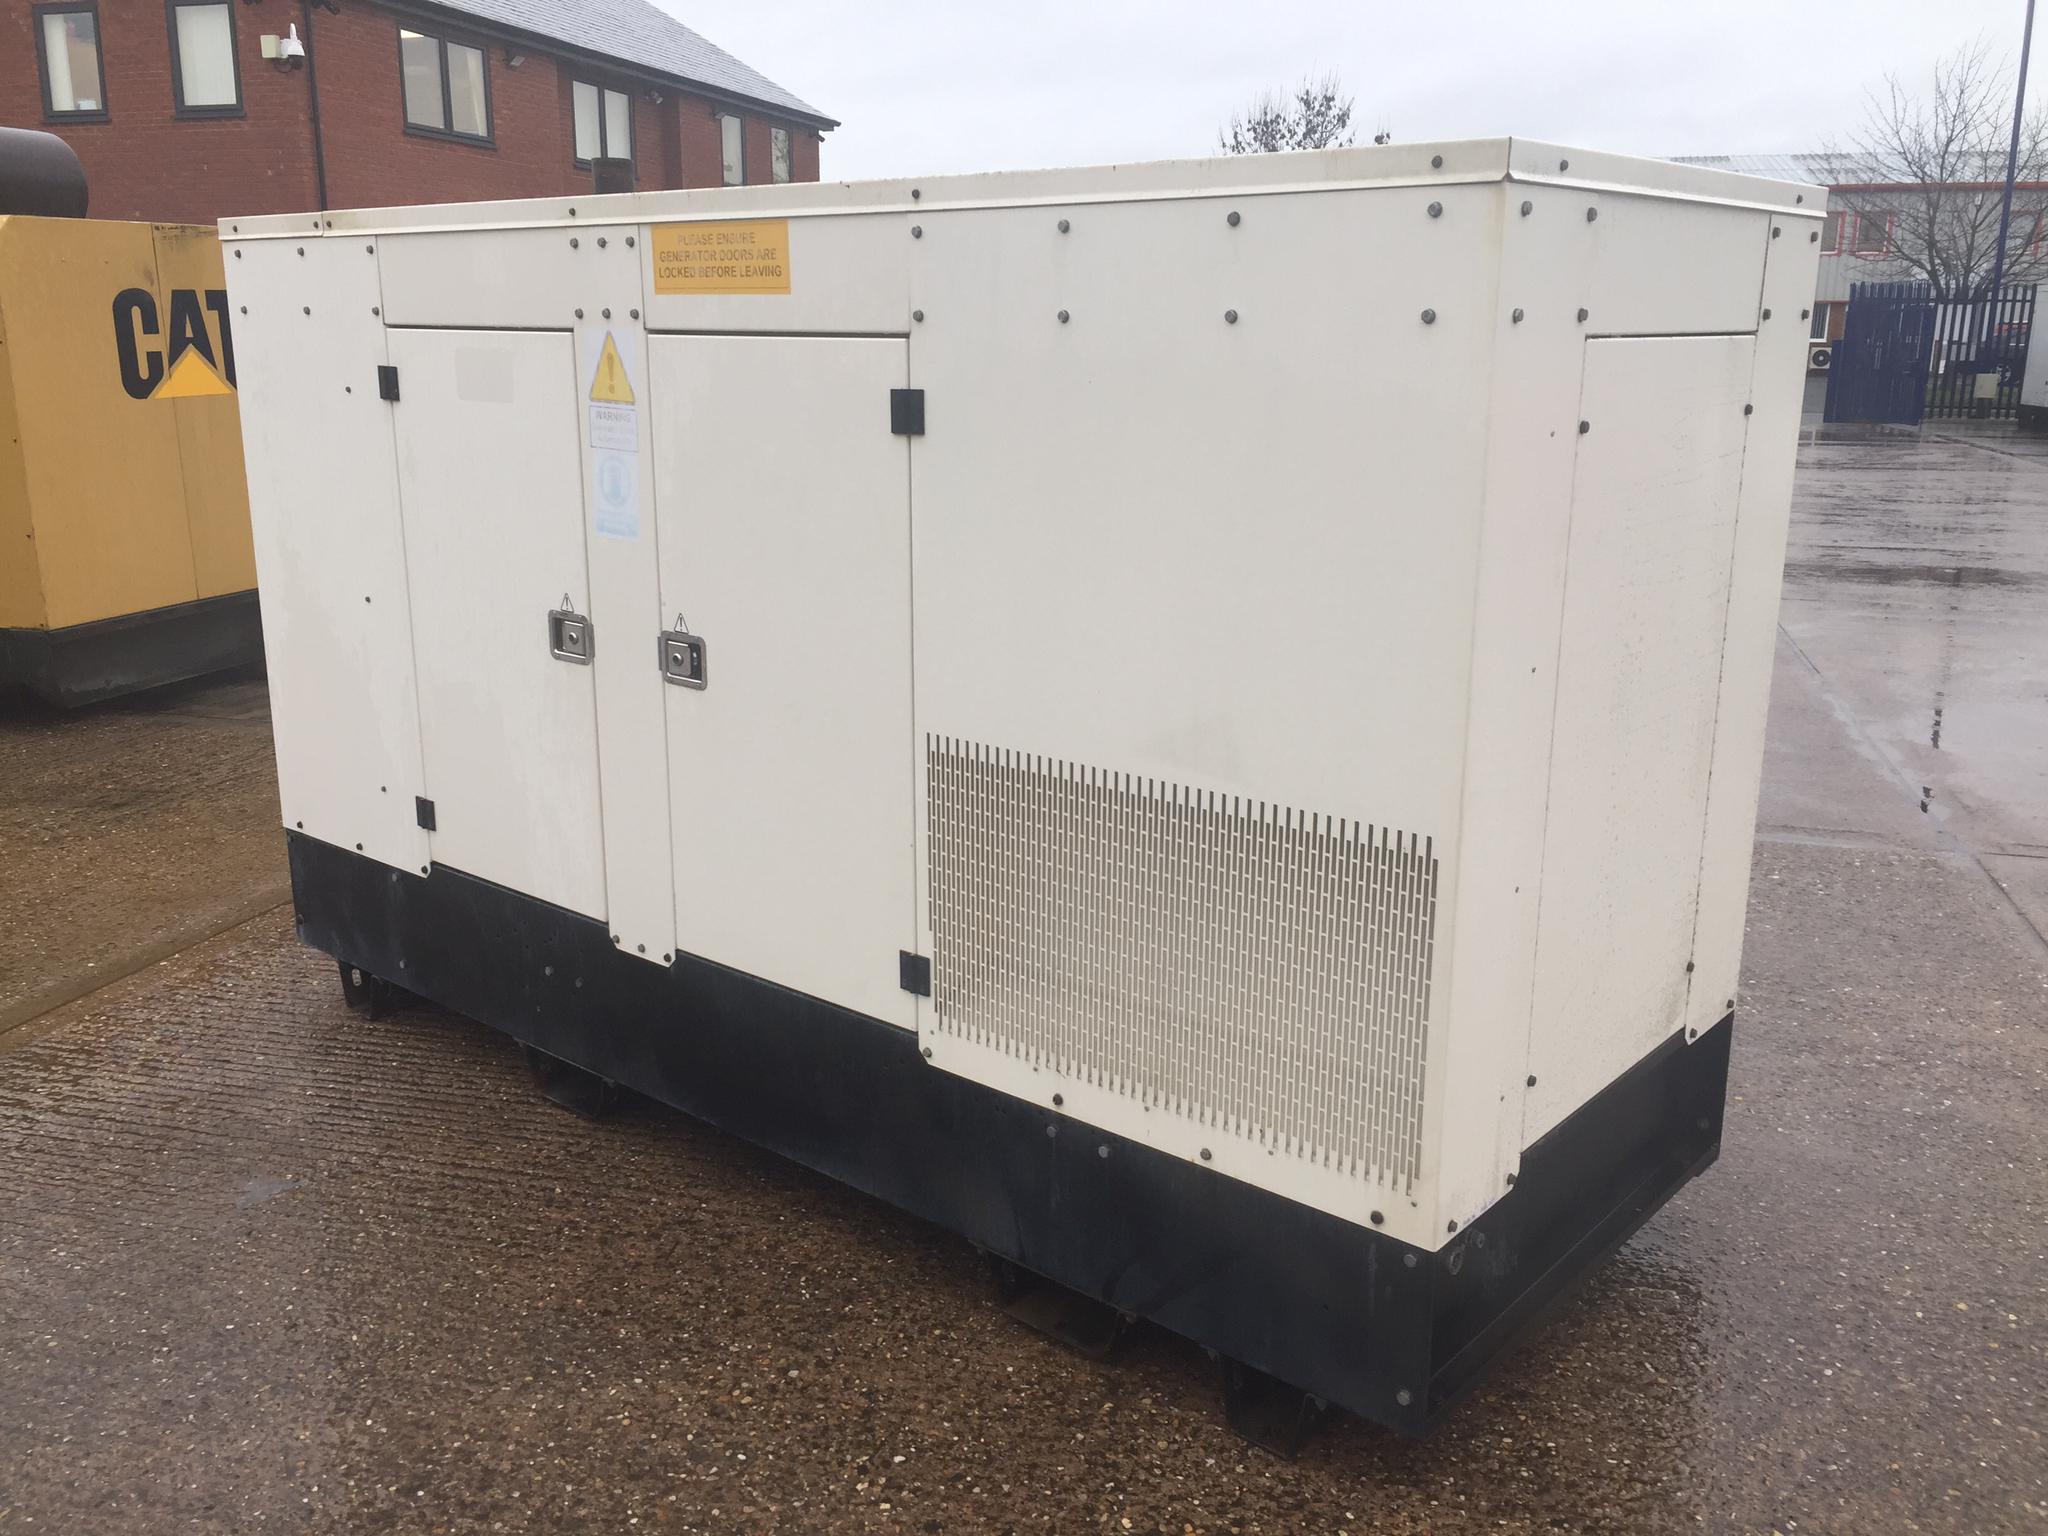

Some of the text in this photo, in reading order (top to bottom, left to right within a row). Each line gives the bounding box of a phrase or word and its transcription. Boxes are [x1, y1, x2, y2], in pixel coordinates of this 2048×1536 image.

[678, 232, 756, 246] PLEASE ENSURE
[659, 248, 777, 262] GENERATOR DOORS ARE
[659, 265, 782, 278] LOCKED BEFORE LEAVING
[112, 287, 237, 400] CAT
[596, 410, 631, 423] WARNING
